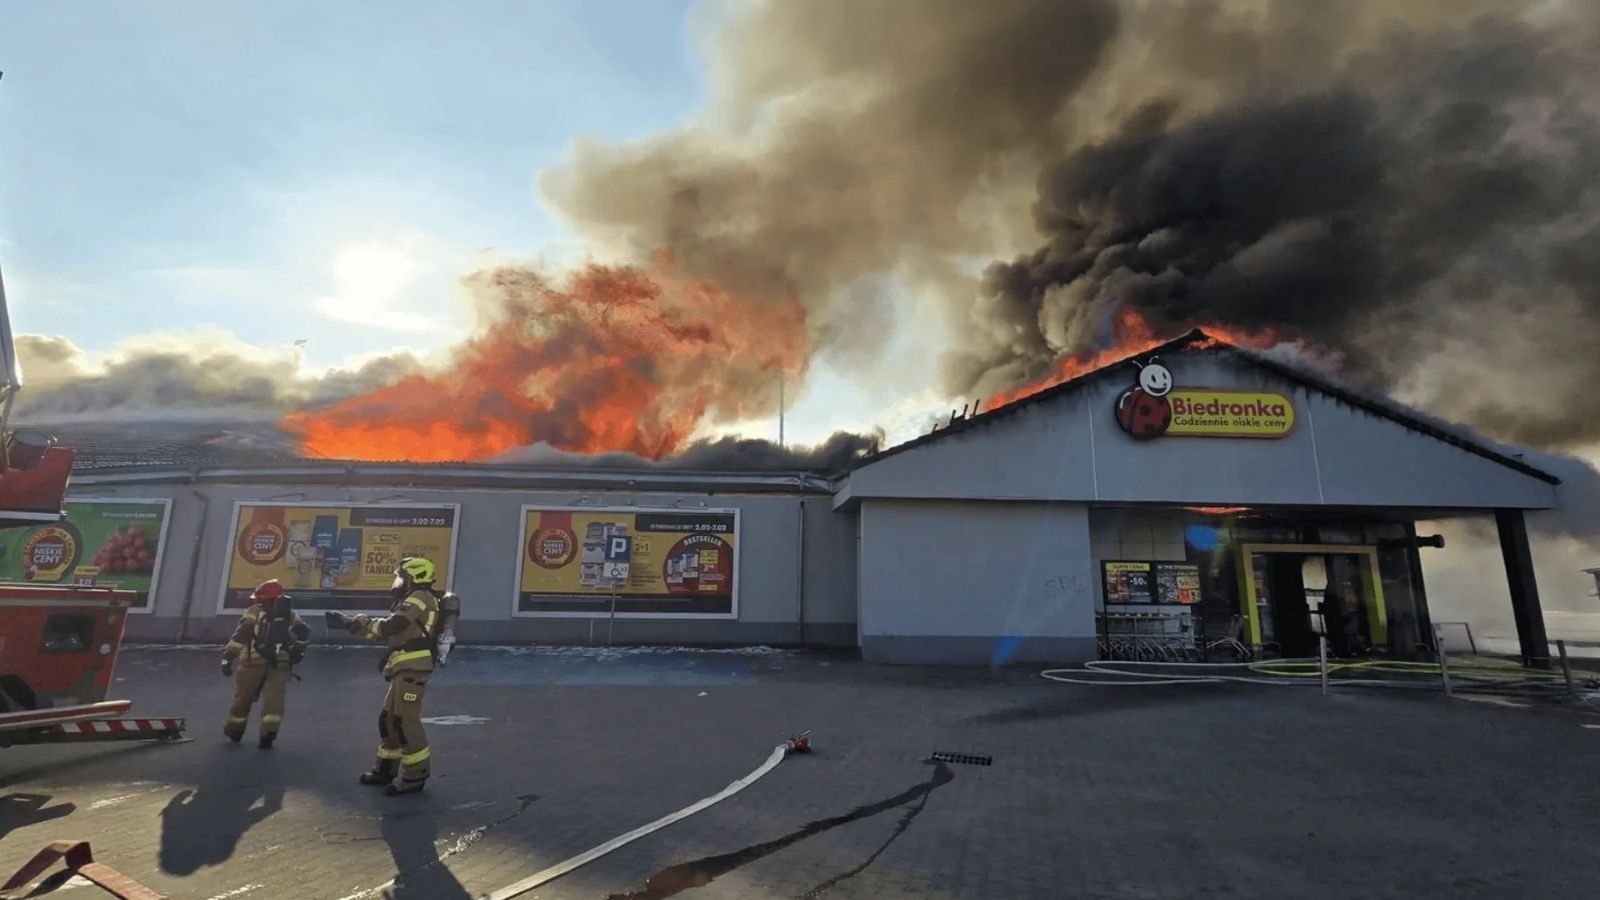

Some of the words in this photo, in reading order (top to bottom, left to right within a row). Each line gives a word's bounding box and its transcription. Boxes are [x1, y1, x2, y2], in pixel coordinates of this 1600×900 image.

[1173, 397, 1285, 417] Biedronka
[1174, 416, 1229, 426] Codziennie
[1233, 417, 1261, 427] niskie
[1264, 419, 1286, 428] ceny
[683, 535, 723, 547] BESTSELLER
[610, 537, 627, 558] P
[33, 555, 63, 565] CENY
[365, 552, 396, 565] 50%
